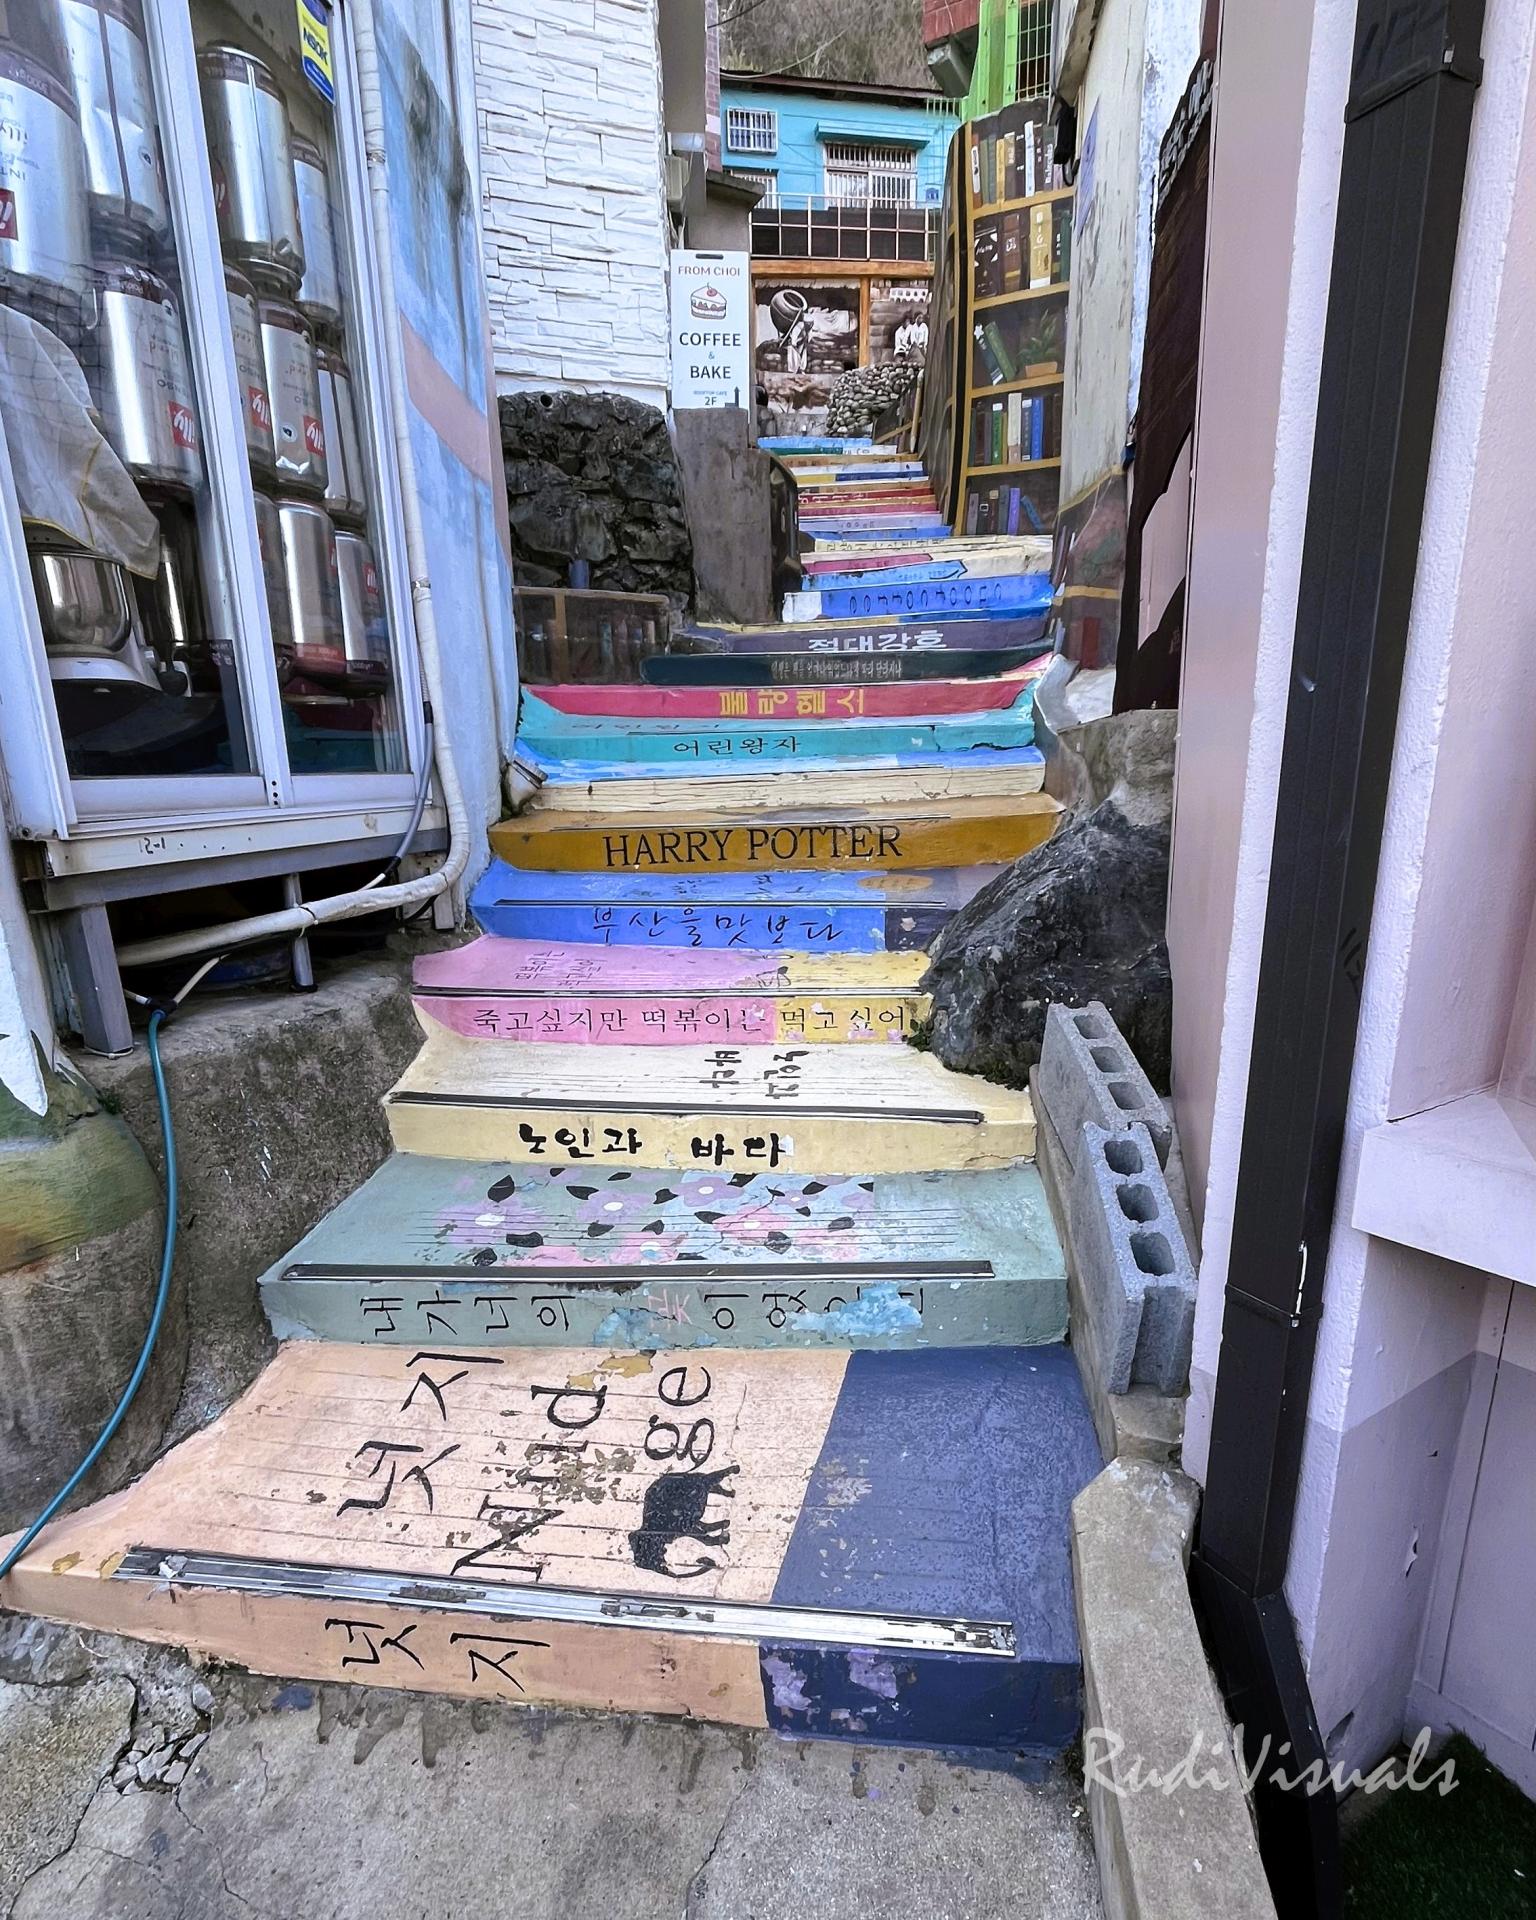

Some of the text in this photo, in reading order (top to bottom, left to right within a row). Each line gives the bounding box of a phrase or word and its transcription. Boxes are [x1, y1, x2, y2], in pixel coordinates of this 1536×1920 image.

[678, 265, 741, 277] FROM CHOI
[679, 332, 742, 347] COFFEE
[708, 351, 715, 360] &
[690, 365, 731, 379] BAKE
[704, 396, 717, 406] 2F
[673, 735, 802, 756] 어린왕자
[604, 825, 903, 867] HARRY POTTER
[518, 1123, 787, 1168] 노인과 바다
[336, 1351, 504, 1517] 넛지
[324, 1616, 551, 1692] 넛지
